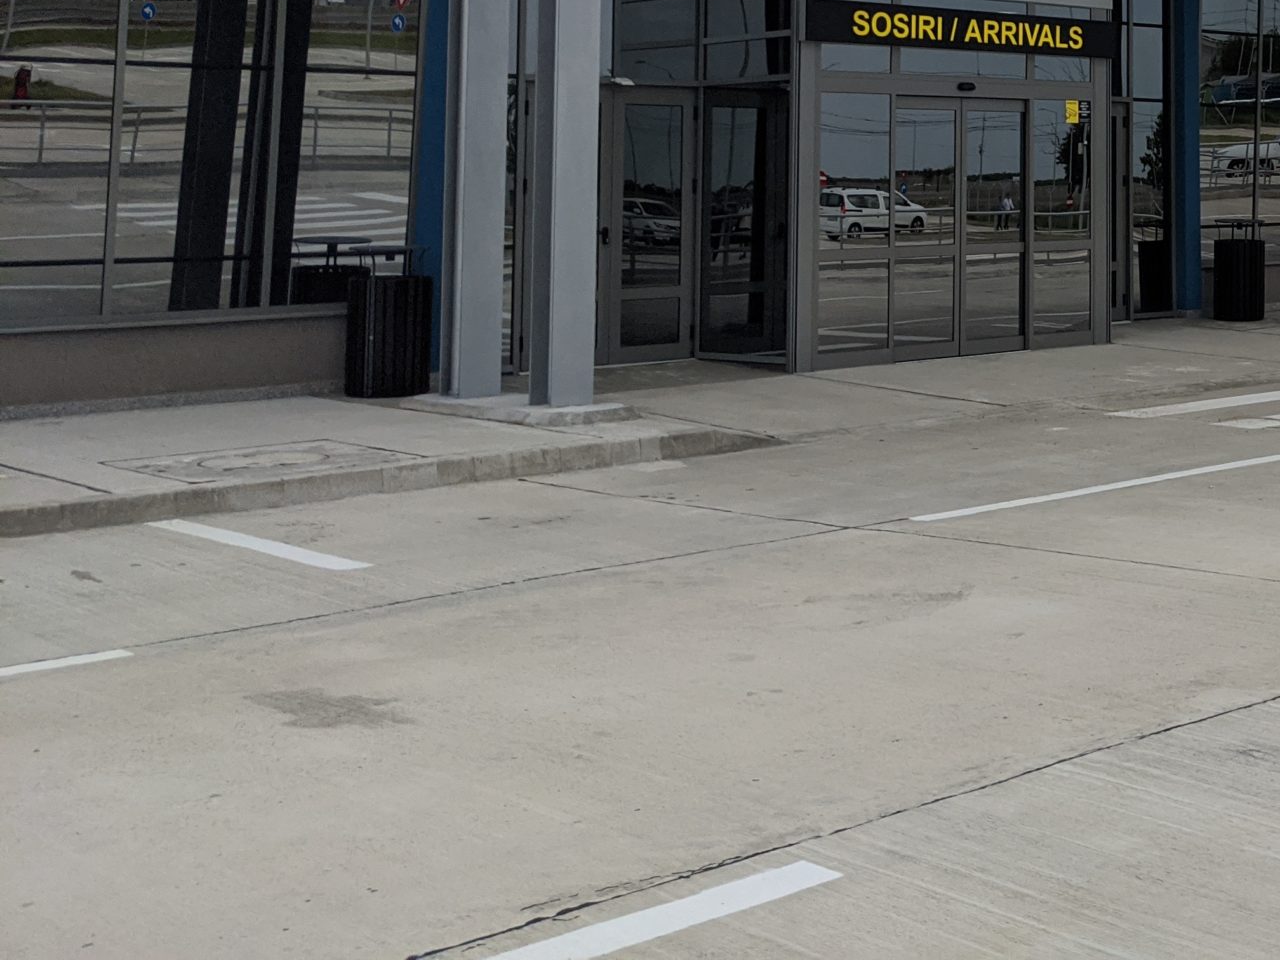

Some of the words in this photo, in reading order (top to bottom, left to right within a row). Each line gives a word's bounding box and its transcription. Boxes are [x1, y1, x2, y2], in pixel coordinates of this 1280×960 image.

[852, 10, 943, 41] SOSIRI
[949, 16, 959, 42] /
[964, 18, 1084, 50] ARRIVALS
